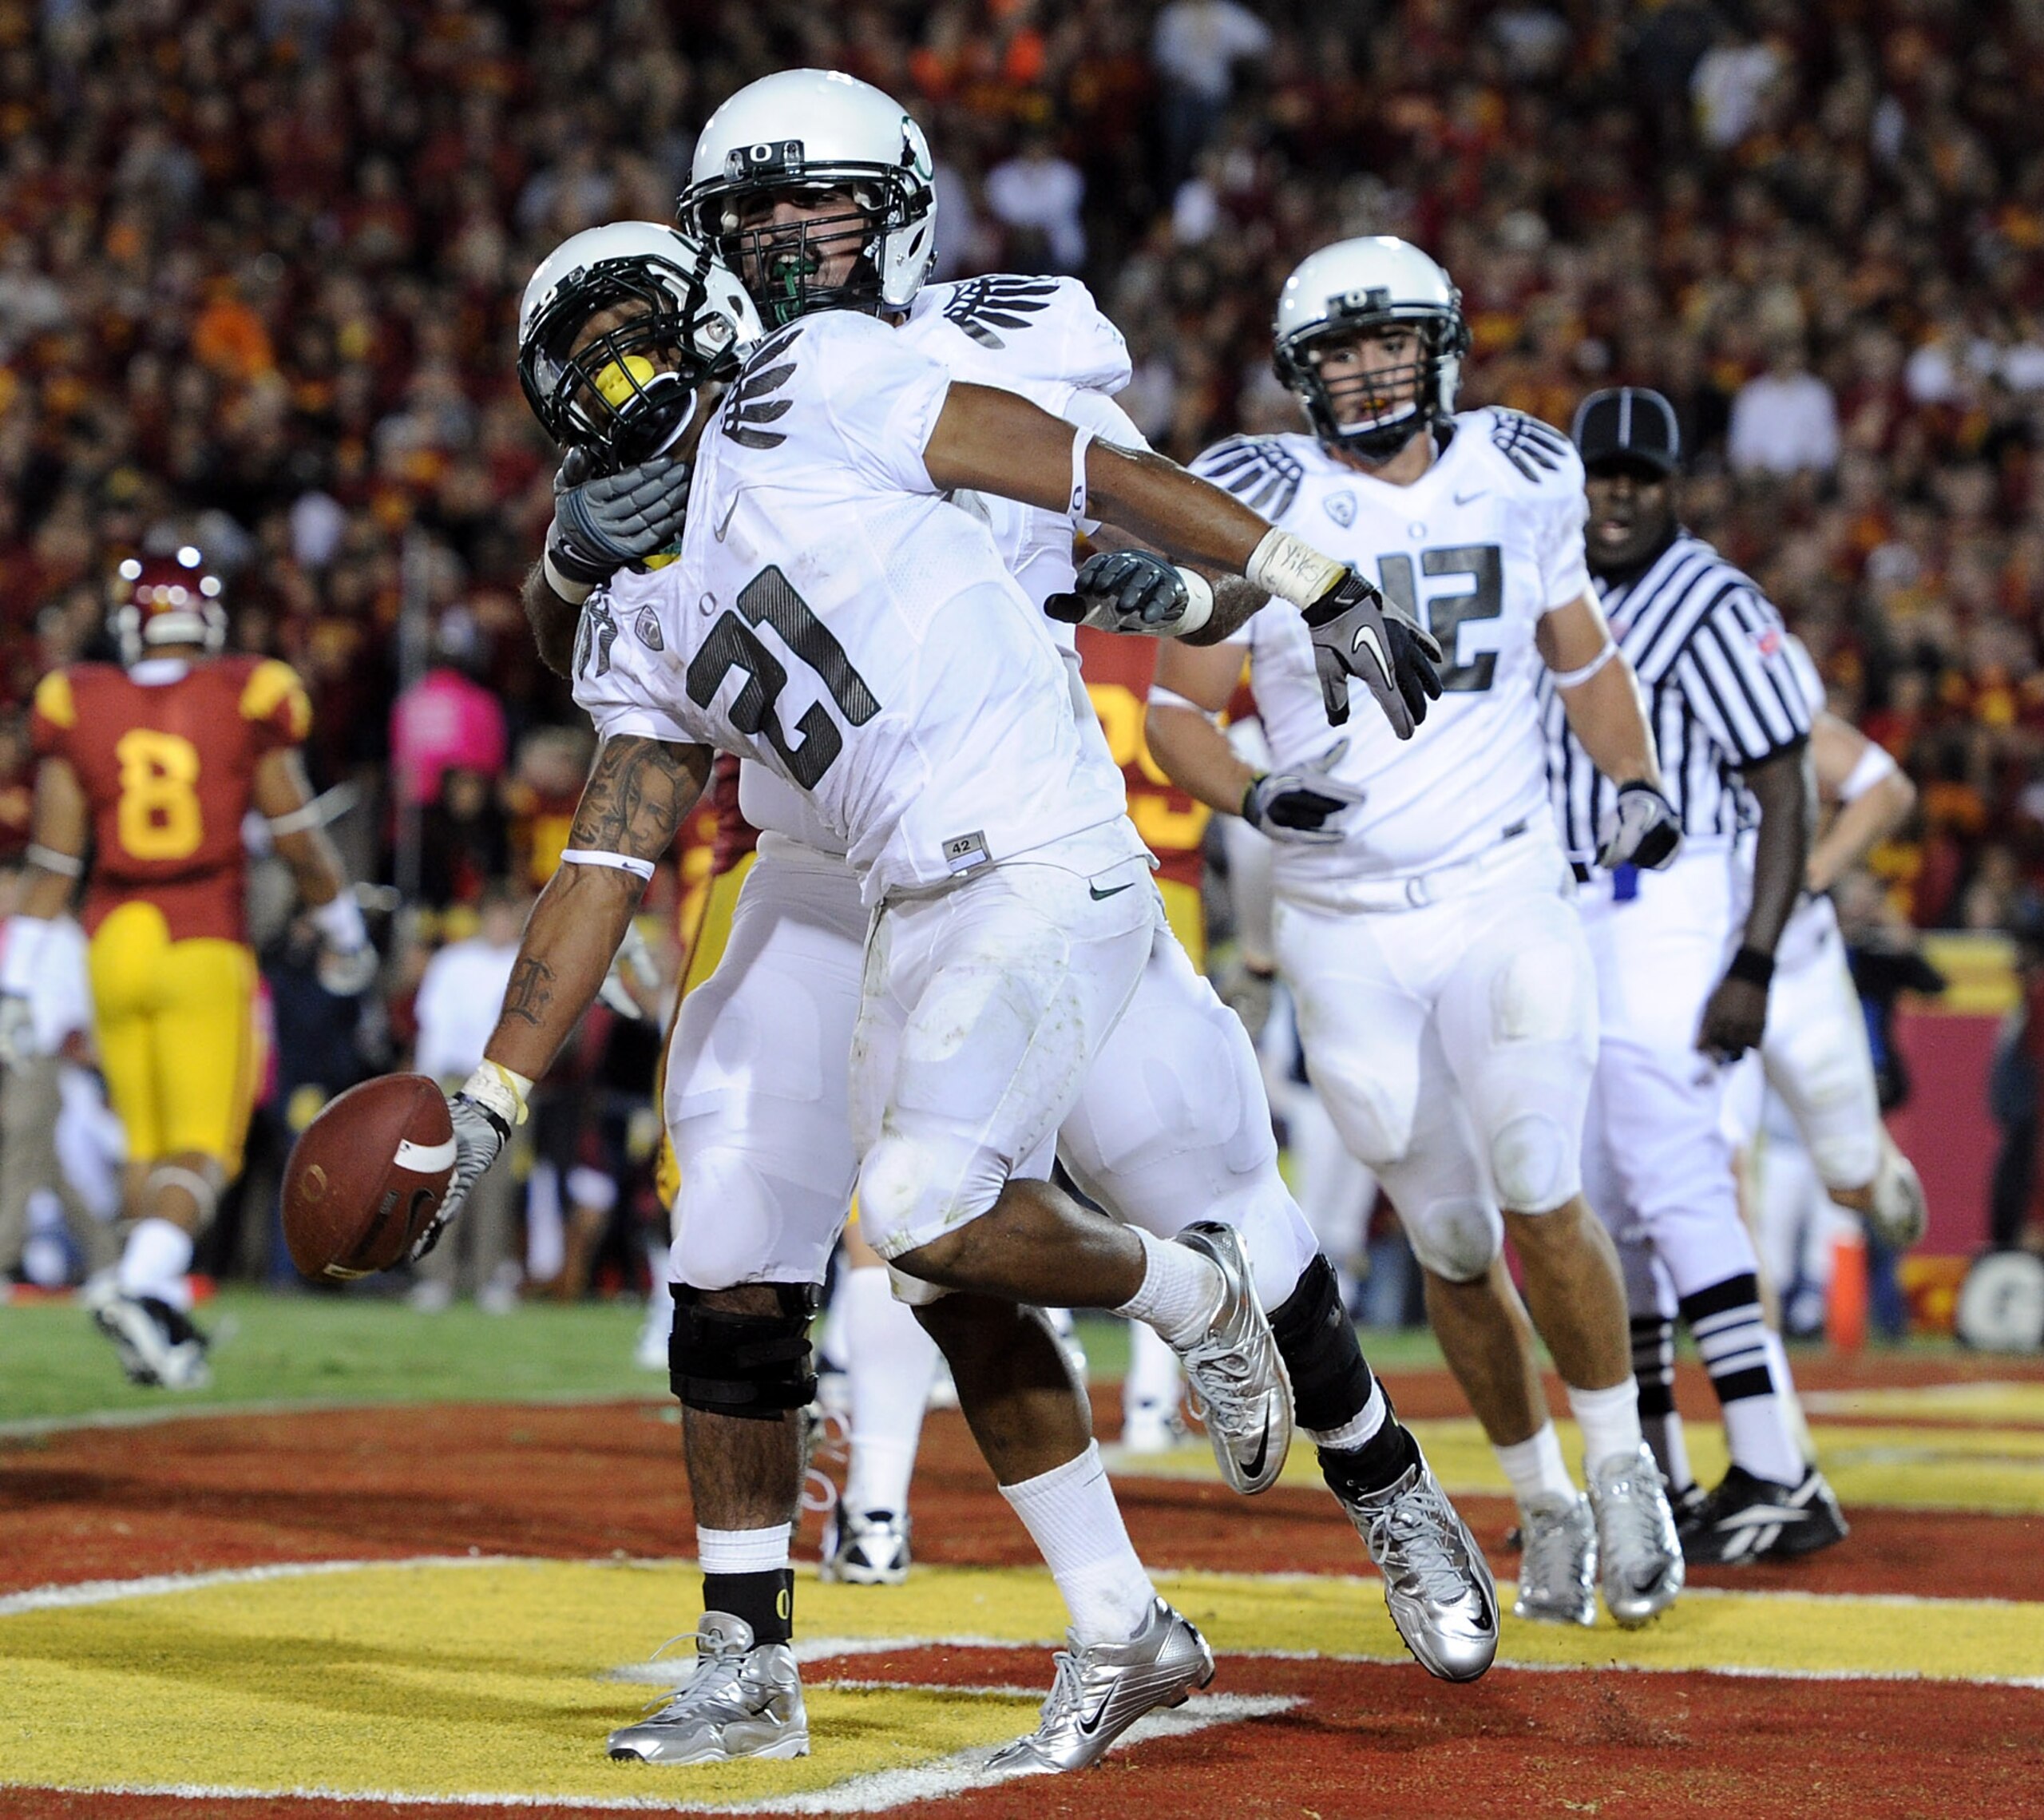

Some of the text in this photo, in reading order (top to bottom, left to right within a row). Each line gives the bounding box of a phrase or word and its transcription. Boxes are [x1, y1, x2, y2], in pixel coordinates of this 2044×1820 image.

[749, 144, 773, 162] O
[699, 592, 717, 617] O
[686, 564, 881, 790] 21
[115, 728, 204, 861] 8
[952, 839, 971, 854] 42
